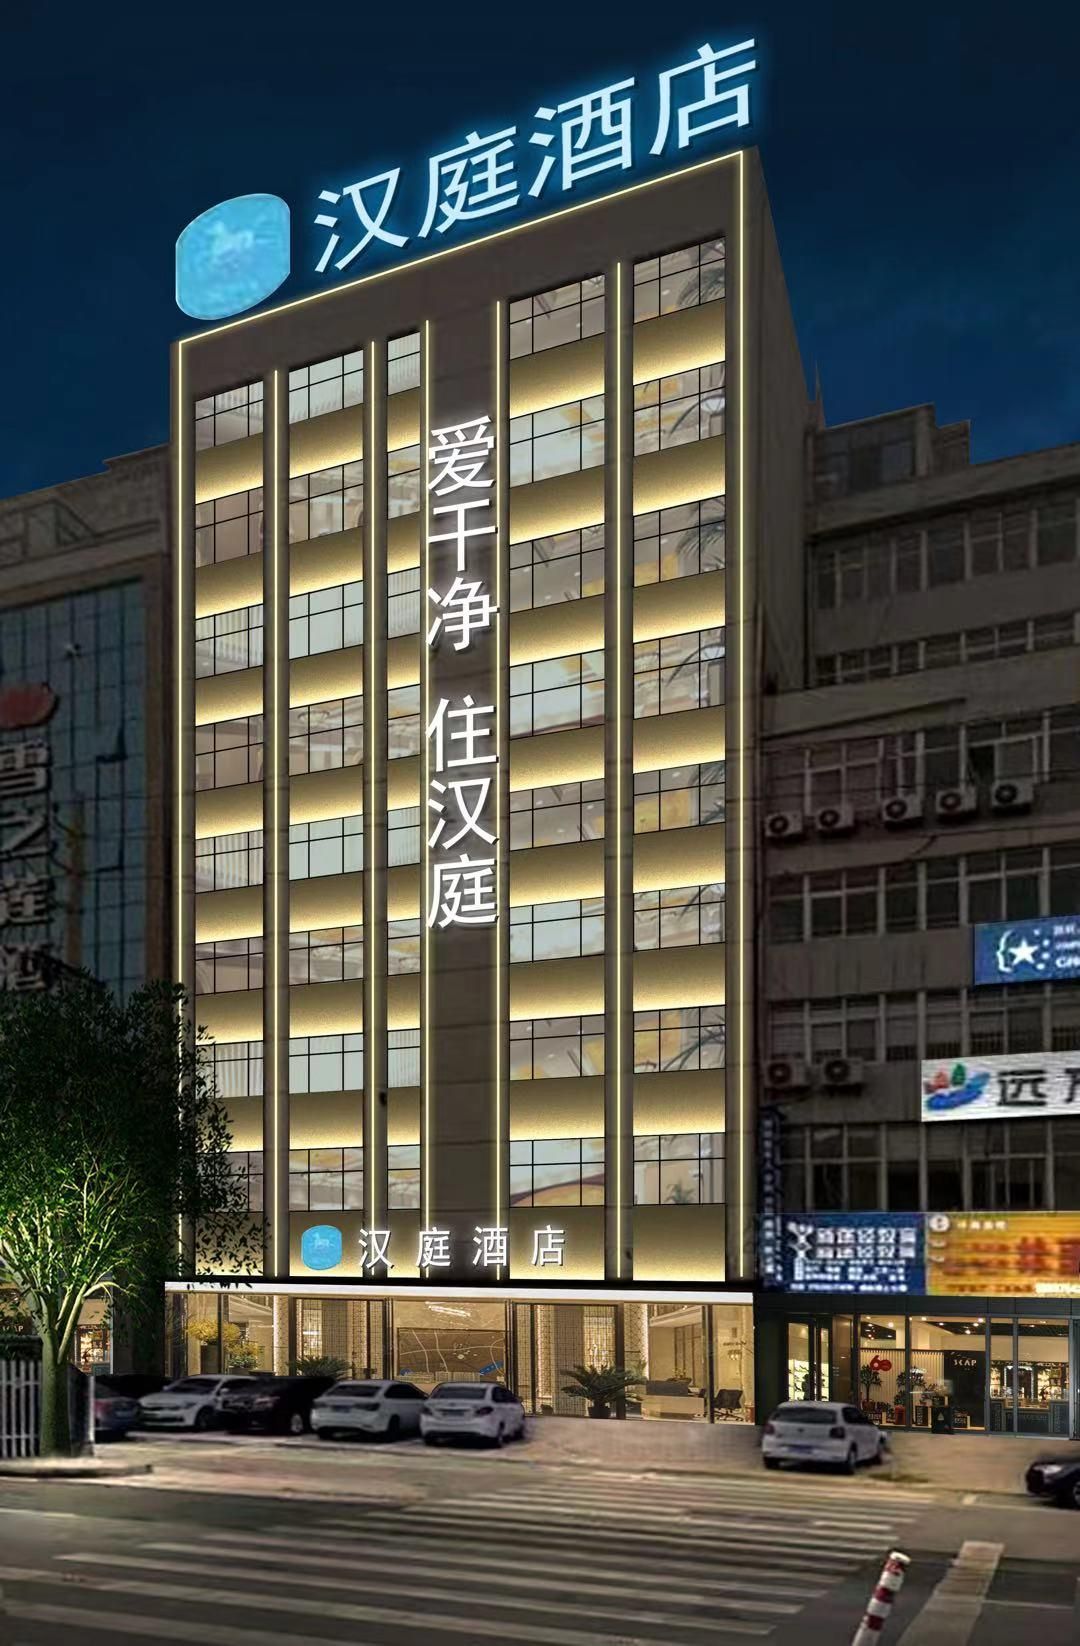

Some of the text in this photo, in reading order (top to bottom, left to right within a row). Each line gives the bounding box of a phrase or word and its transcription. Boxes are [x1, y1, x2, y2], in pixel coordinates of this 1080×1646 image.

[314, 38, 756, 272] 汉庭酒店
[425, 415, 498, 929] 爱干净 住汉庭
[358, 1225, 566, 1269] 汉庭酒店
